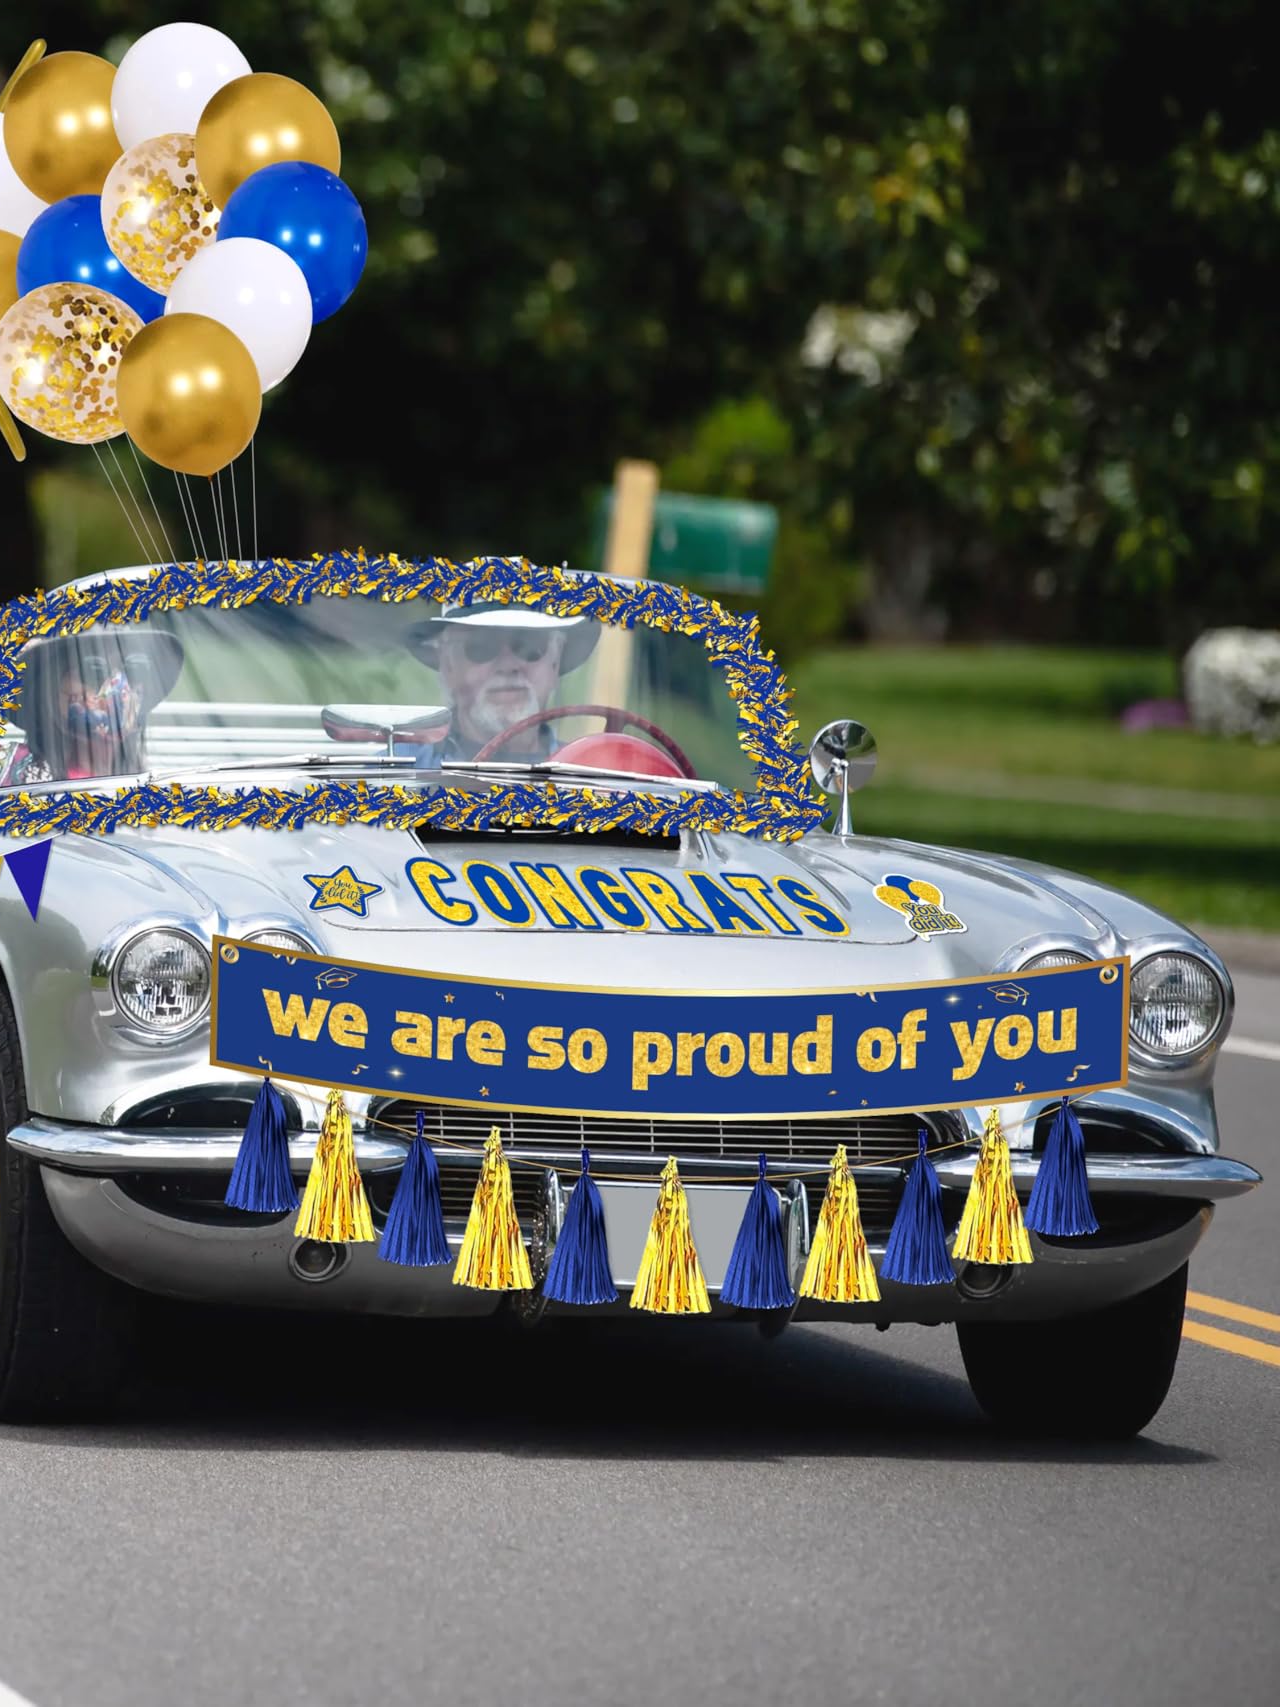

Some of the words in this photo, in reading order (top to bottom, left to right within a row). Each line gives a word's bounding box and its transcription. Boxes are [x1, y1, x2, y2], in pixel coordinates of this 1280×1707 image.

[405, 856, 851, 937] CONGRATS
[902, 903, 942, 916] You
[911, 916, 941, 931] did
[262, 988, 369, 1049] we
[390, 1009, 506, 1066] are
[526, 1025, 608, 1074] so
[631, 1014, 834, 1091] proud
[856, 1008, 928, 1073] of
[949, 1007, 1078, 1082] you
